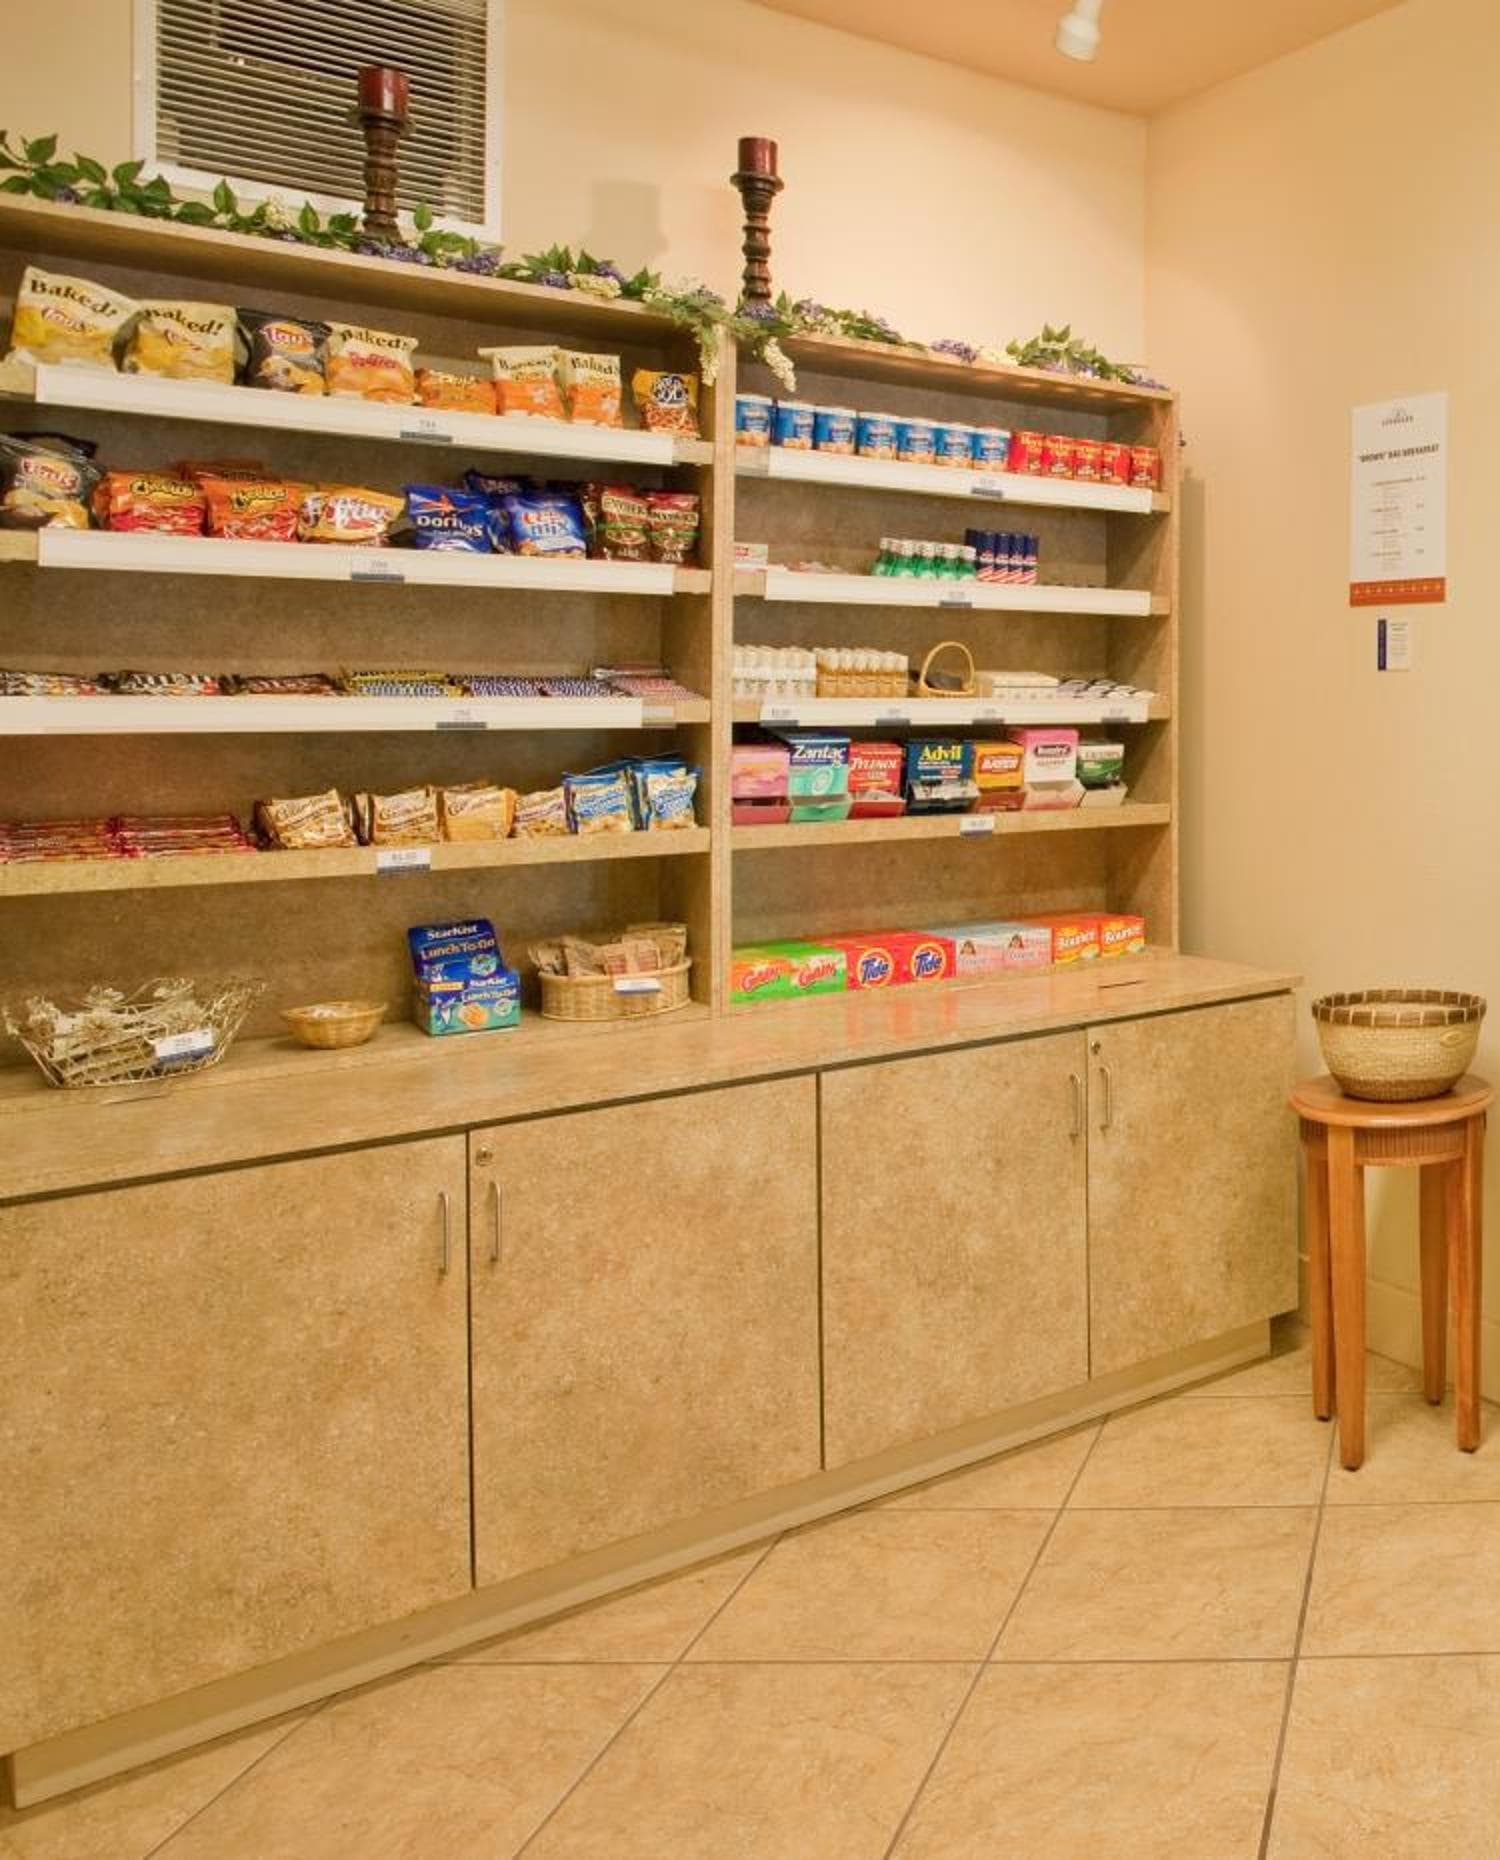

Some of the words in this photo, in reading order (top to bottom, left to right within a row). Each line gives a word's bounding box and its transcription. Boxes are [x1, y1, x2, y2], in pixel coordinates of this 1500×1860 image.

[30, 278, 119, 318] Baked!
[416, 514, 483, 538] Doritos
[793, 744, 846, 761] Zantac
[920, 743, 962, 762] Advil
[427, 924, 479, 941] StarKist
[420, 942, 460, 961] Lunch
[860, 957, 889, 984] Tide
[915, 951, 943, 977] Tide
